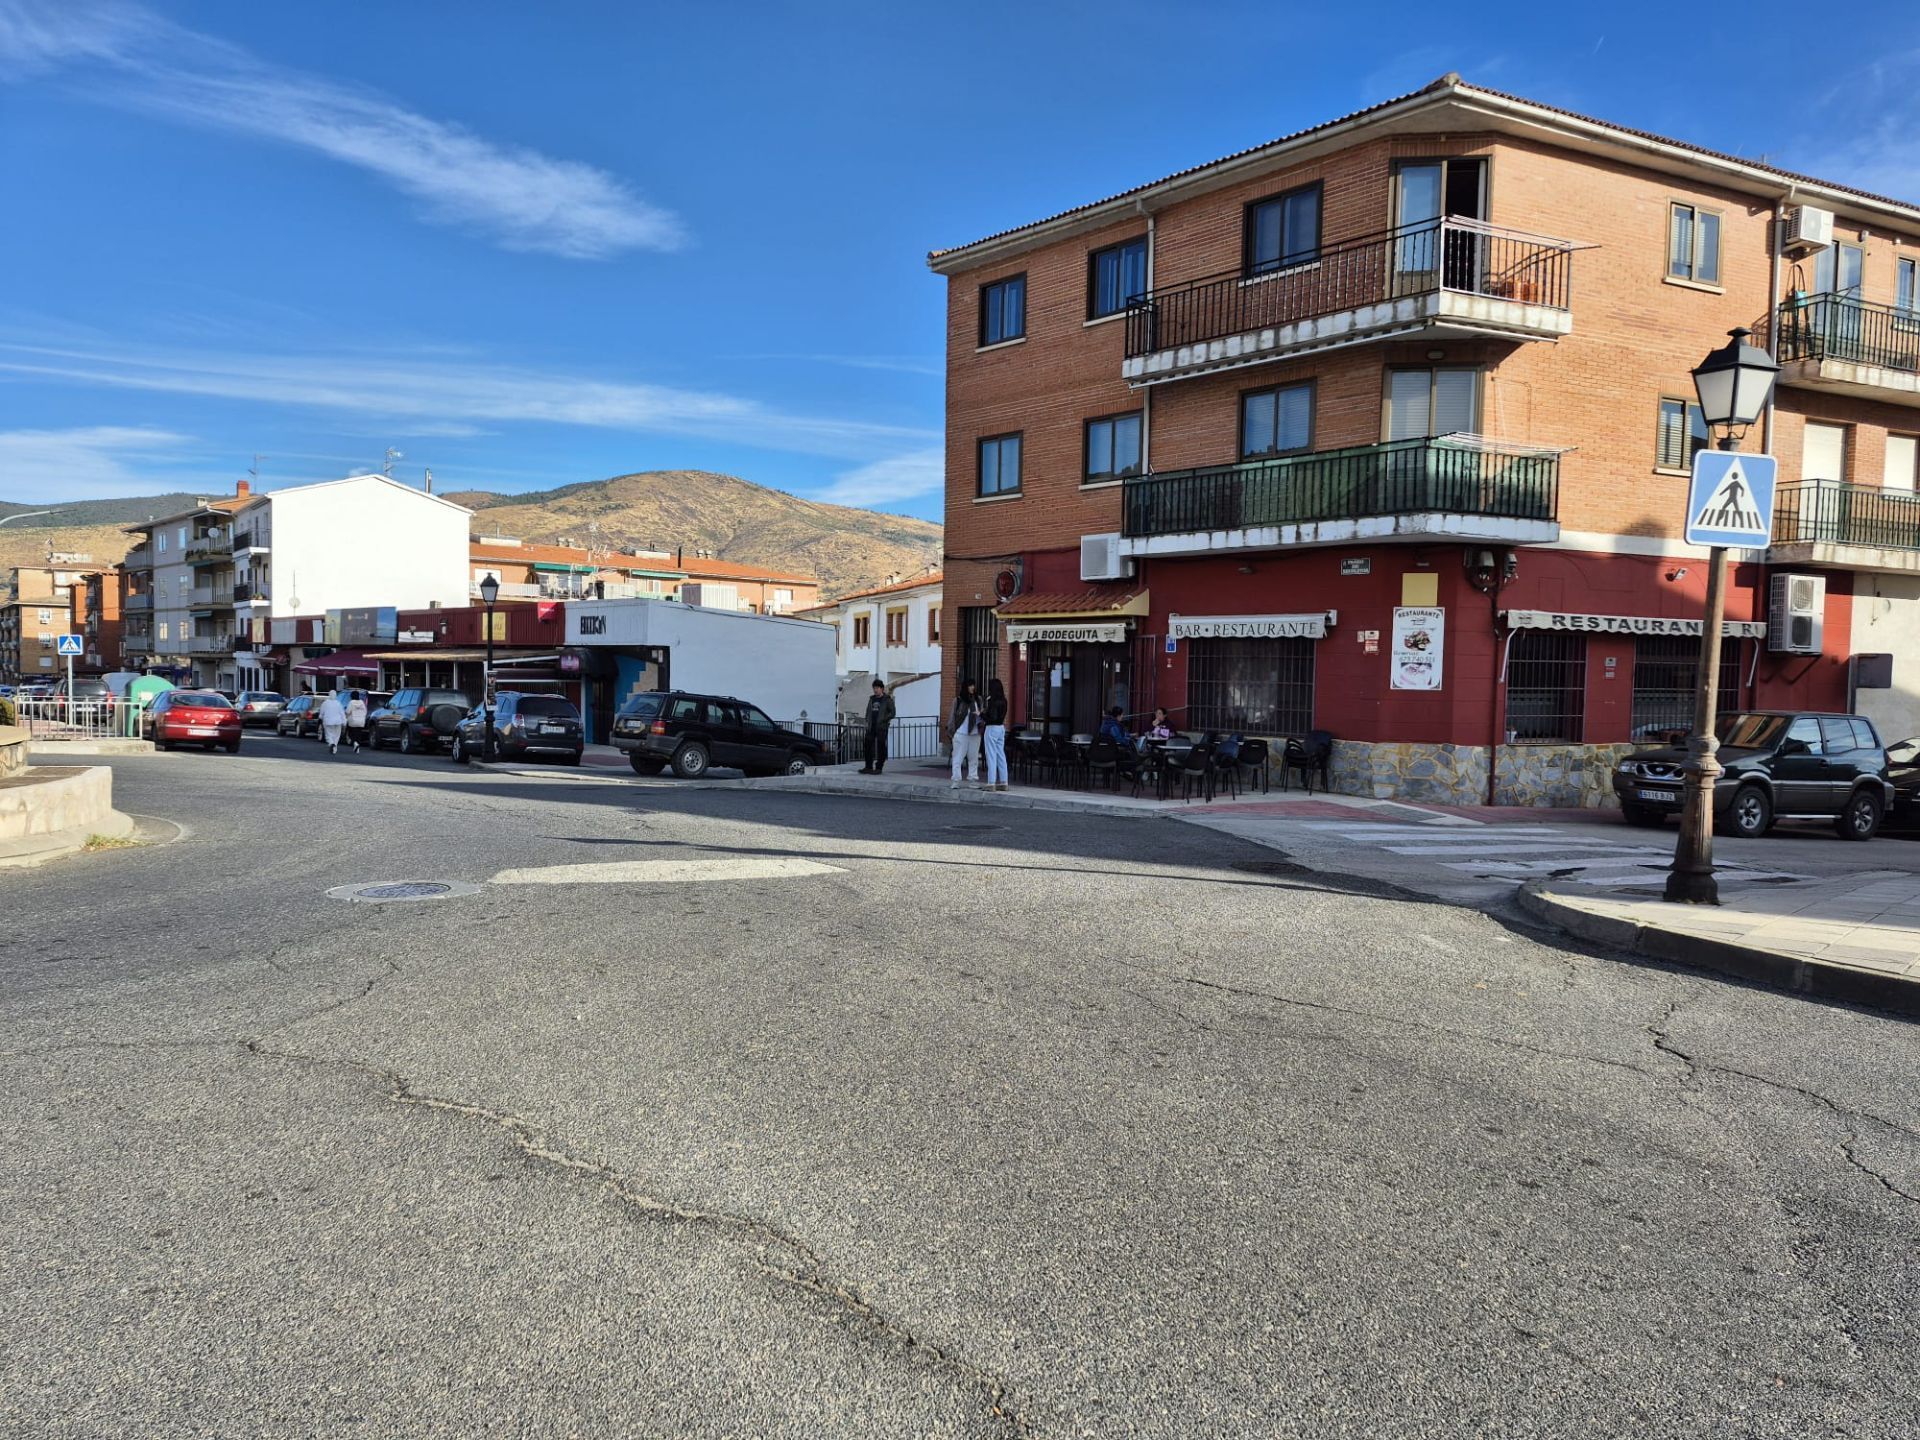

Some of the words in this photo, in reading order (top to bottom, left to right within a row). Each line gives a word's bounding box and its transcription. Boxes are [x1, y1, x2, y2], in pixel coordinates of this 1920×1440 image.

[1398, 610, 1440, 619] RESTAURANTE
[1175, 624, 1201, 636] BAR
[1213, 622, 1318, 636] RESTAURANTE
[1551, 614, 1730, 634] RESTAURANE
[1027, 630, 1039, 639] LA
[1041, 629, 1098, 639] BODEGUITA
